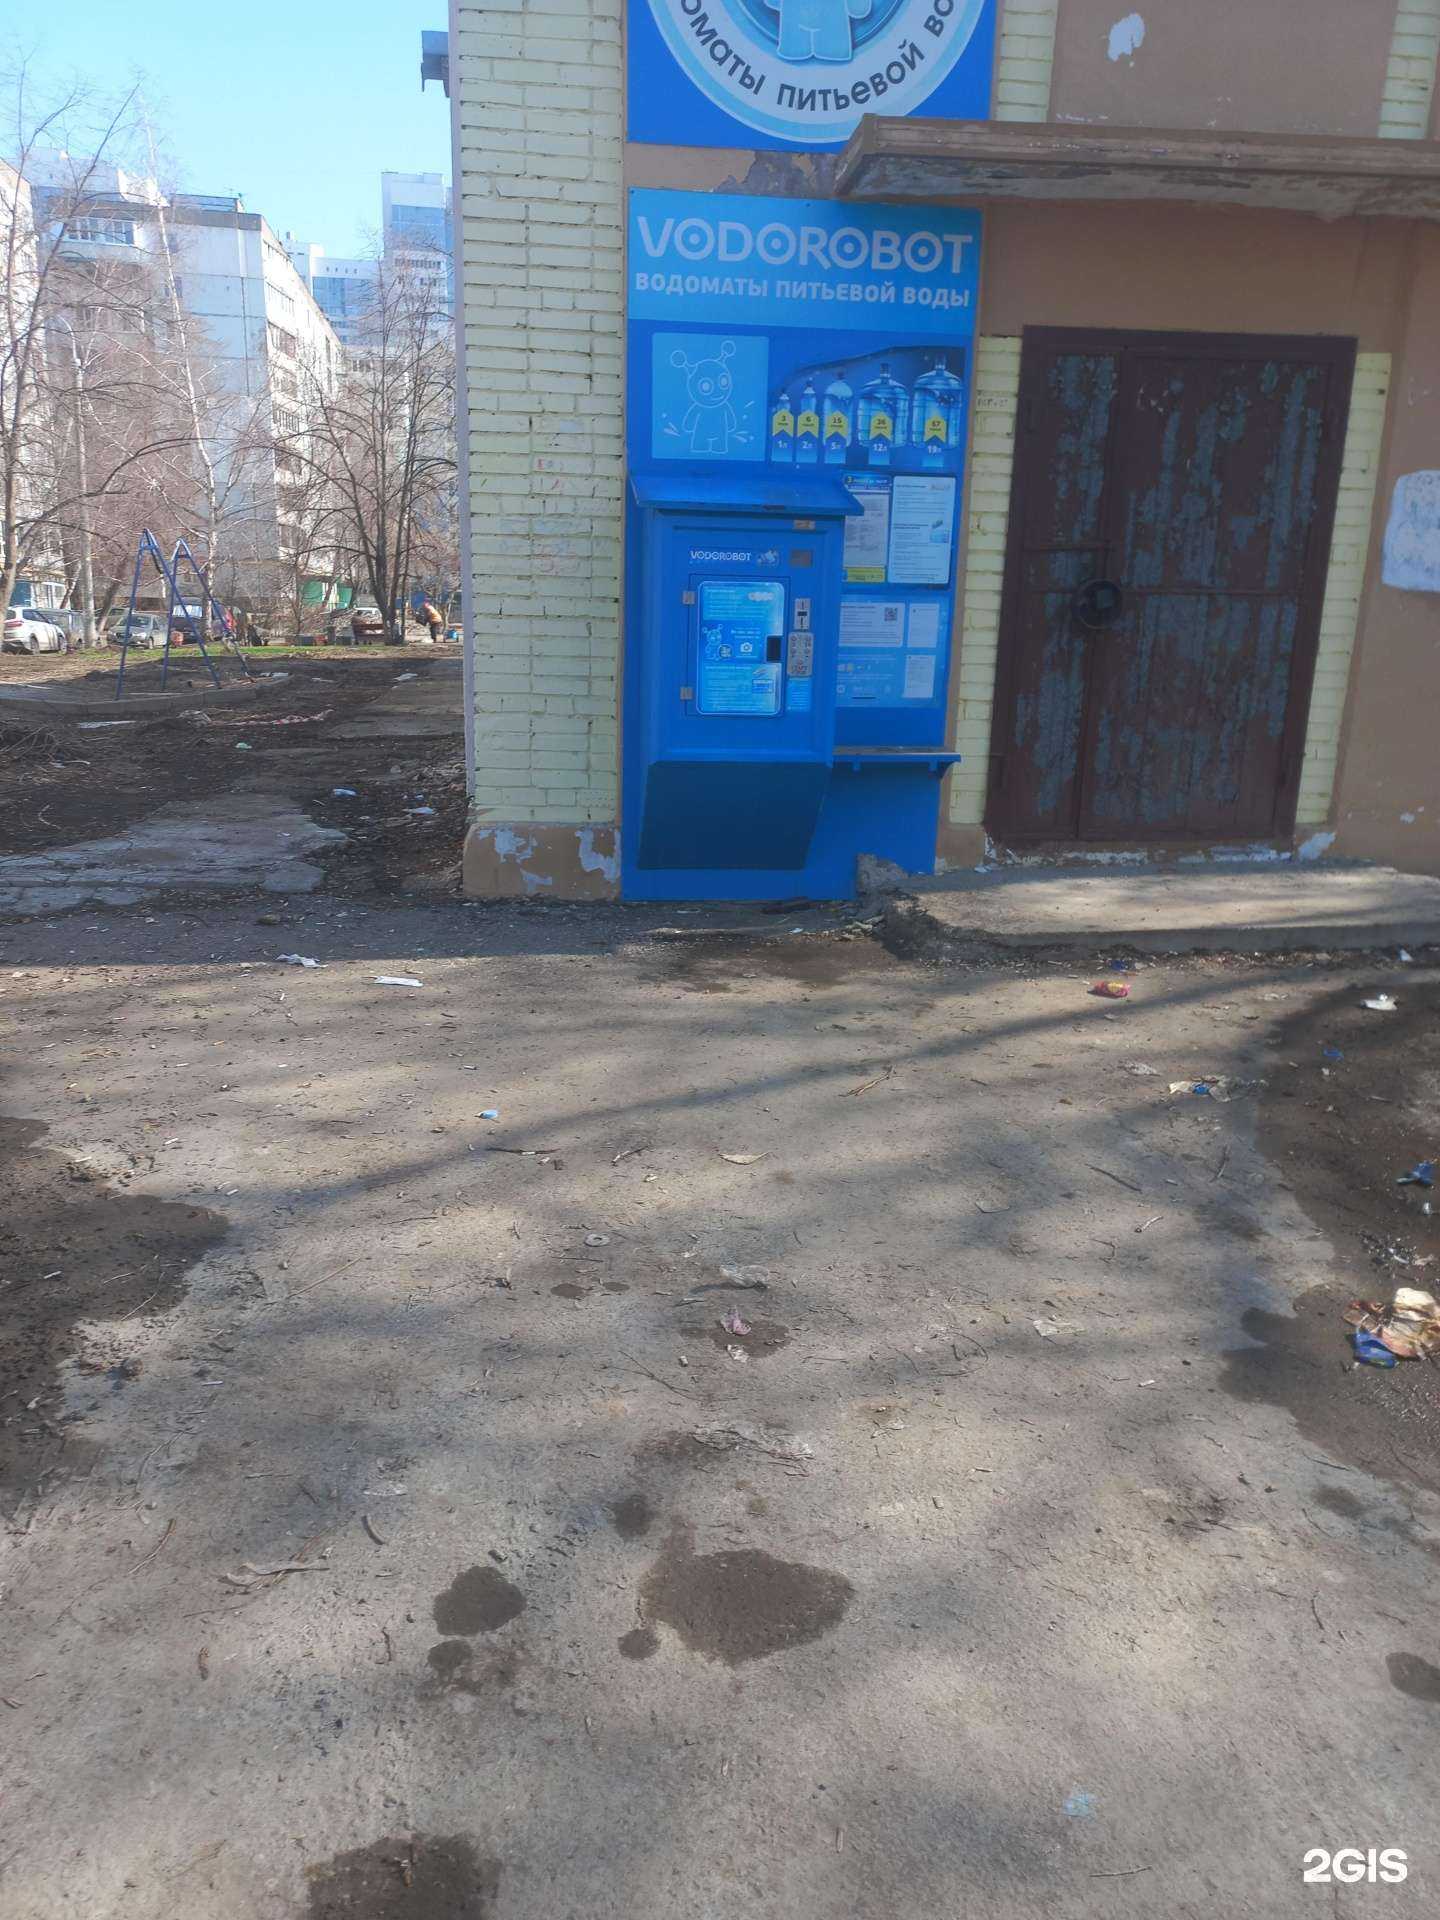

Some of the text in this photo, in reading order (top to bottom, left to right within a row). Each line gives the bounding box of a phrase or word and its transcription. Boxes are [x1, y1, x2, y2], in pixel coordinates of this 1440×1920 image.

[636, 215, 973, 274] VODOROBOT
[635, 272, 970, 310] ВОДОМАТЫ ПИТЬЕВОЙ ВОДЫ
[690, 550, 751, 561] VODOROBOT
